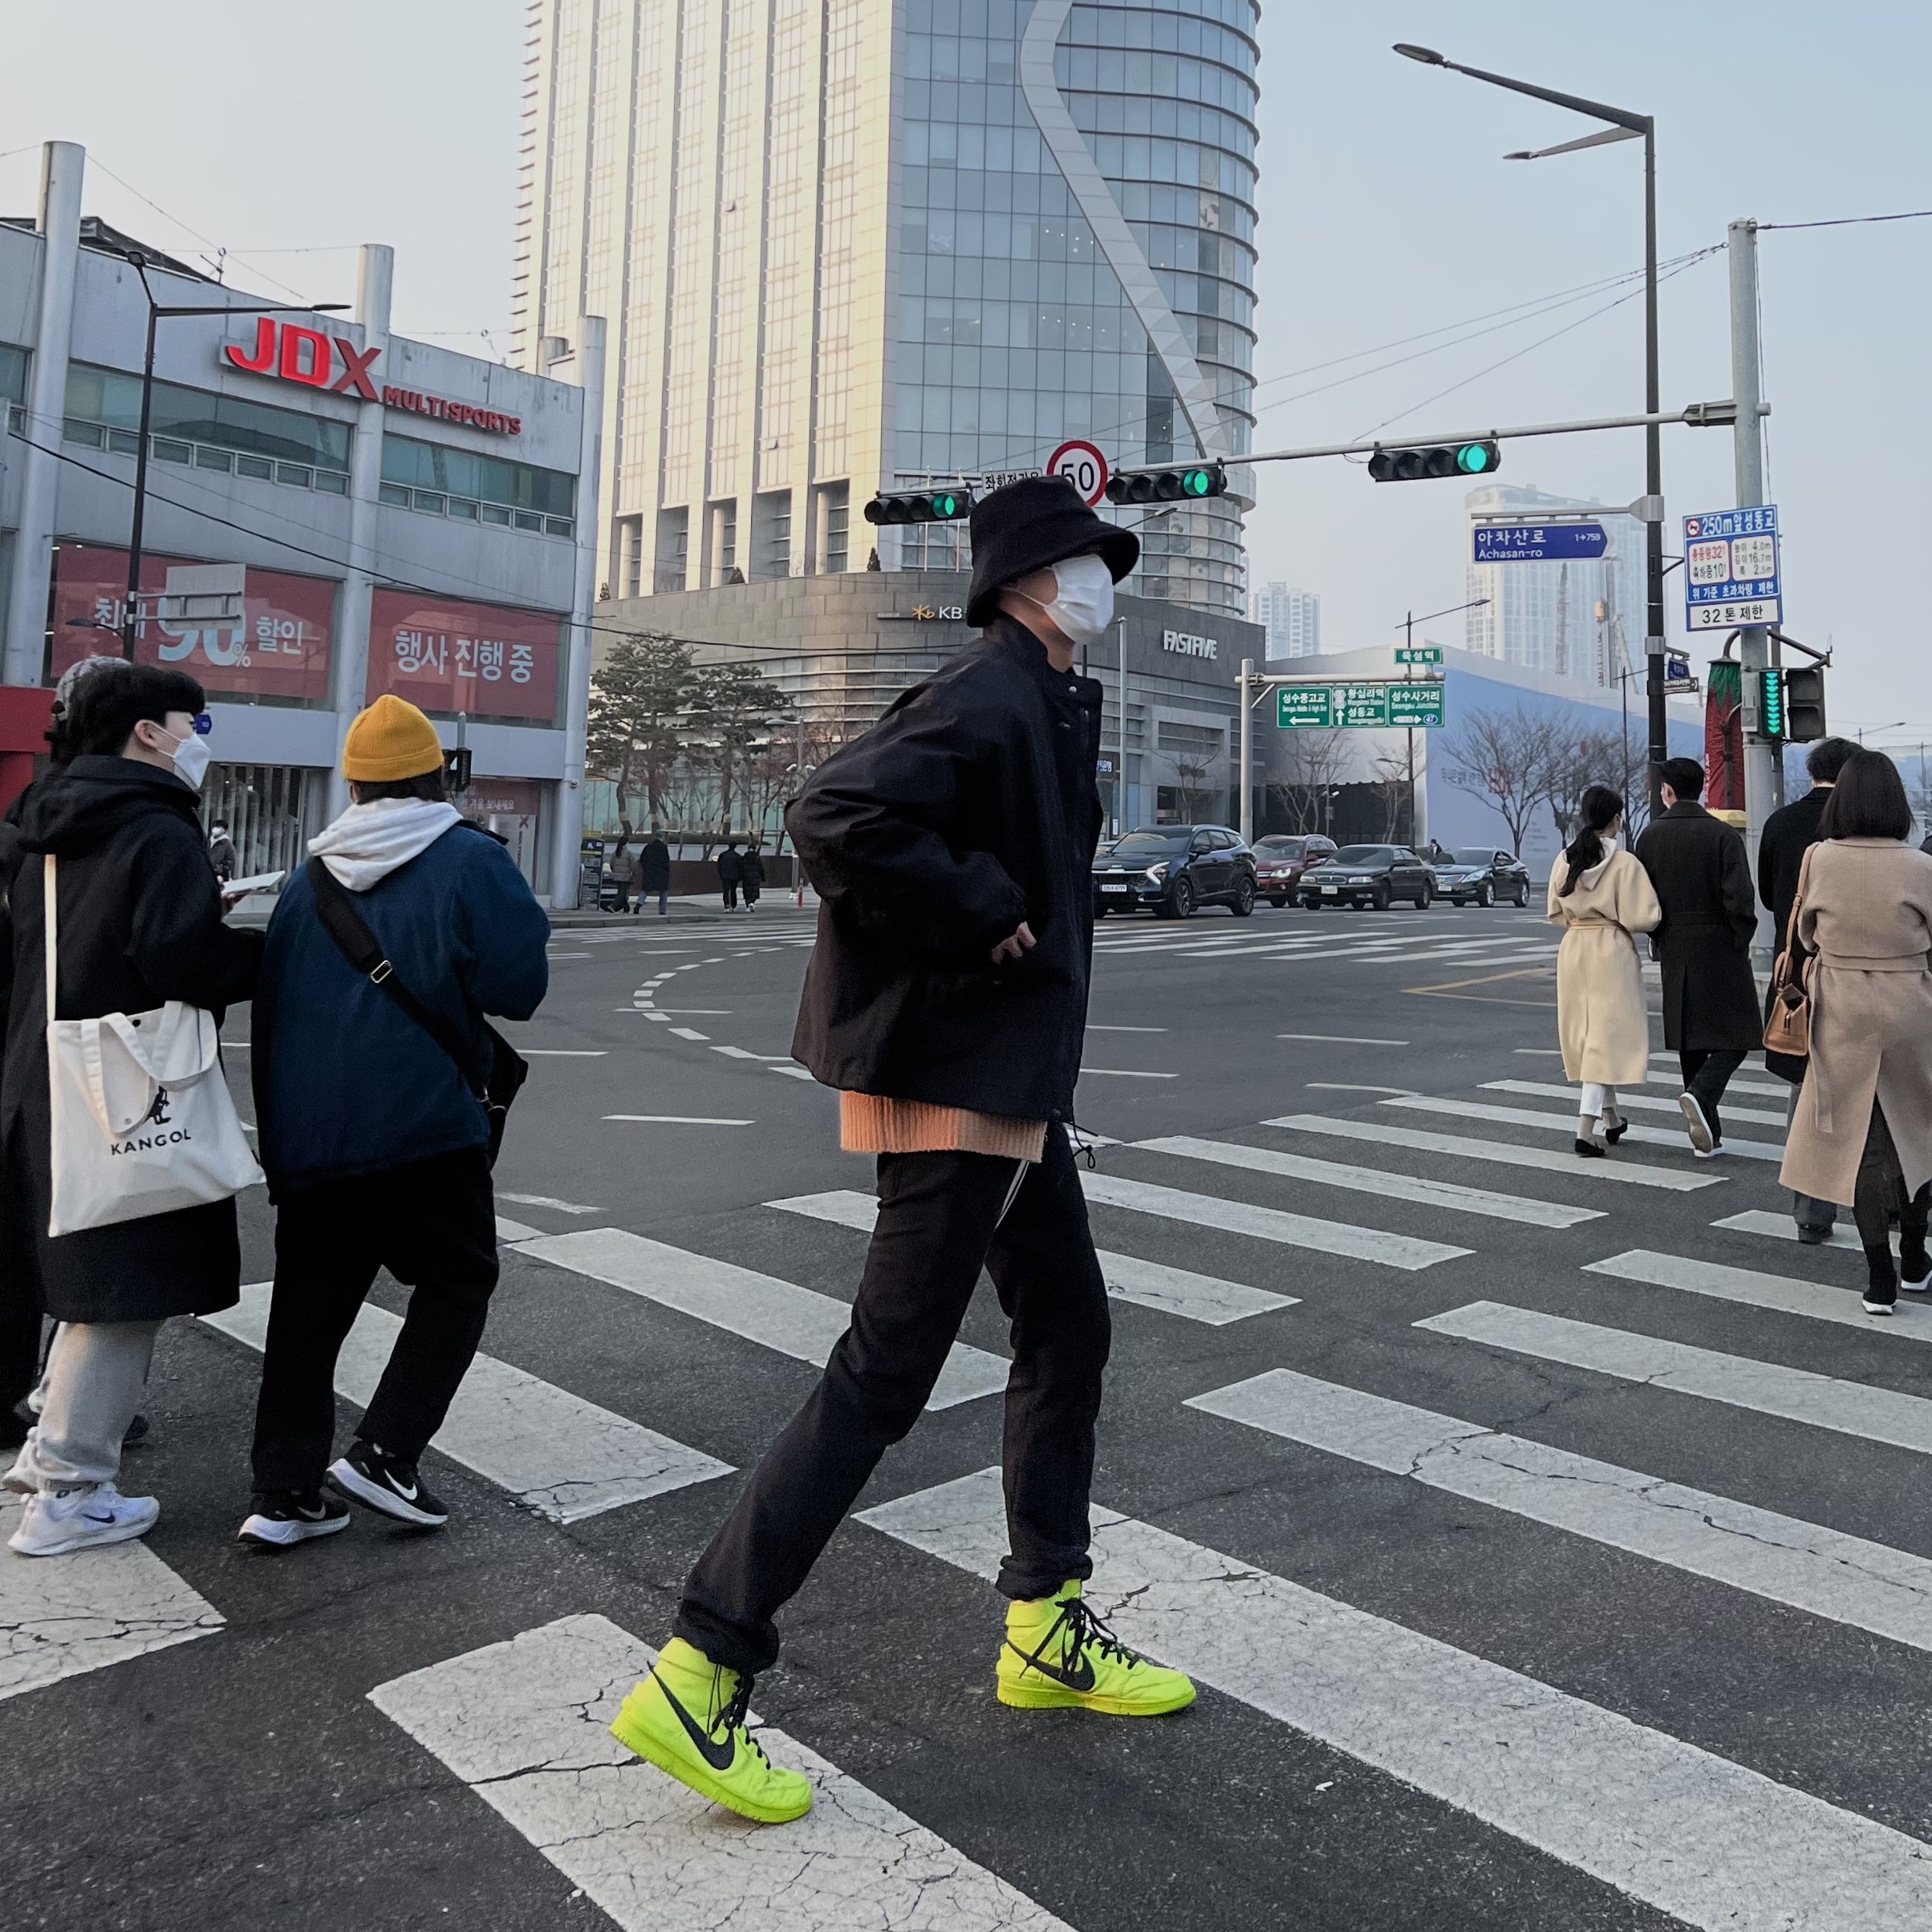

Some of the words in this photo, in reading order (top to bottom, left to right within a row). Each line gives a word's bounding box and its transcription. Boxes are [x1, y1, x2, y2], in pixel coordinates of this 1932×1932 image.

[227, 317, 383, 401] JDX
[383, 384, 522, 436] MULTISPORTS
[1061, 461, 1095, 492] 50
[1477, 529, 1547, 546] 아차산로
[1478, 548, 1544, 559] Achasan-ro
[1703, 586, 1719, 599] 기준
[1722, 582, 1753, 597] 초과차량
[1758, 581, 1774, 595] 제한
[1739, 604, 1764, 620] 제한
[256, 616, 303, 656] 할인
[395, 630, 448, 676] 행사
[454, 639, 504, 681] 진행
[509, 643, 534, 683] 중
[1282, 692, 1326, 704] 성수중고교
[1391, 690, 1440, 702] 성수사거리
[110, 1128, 193, 1156] KANGOL
